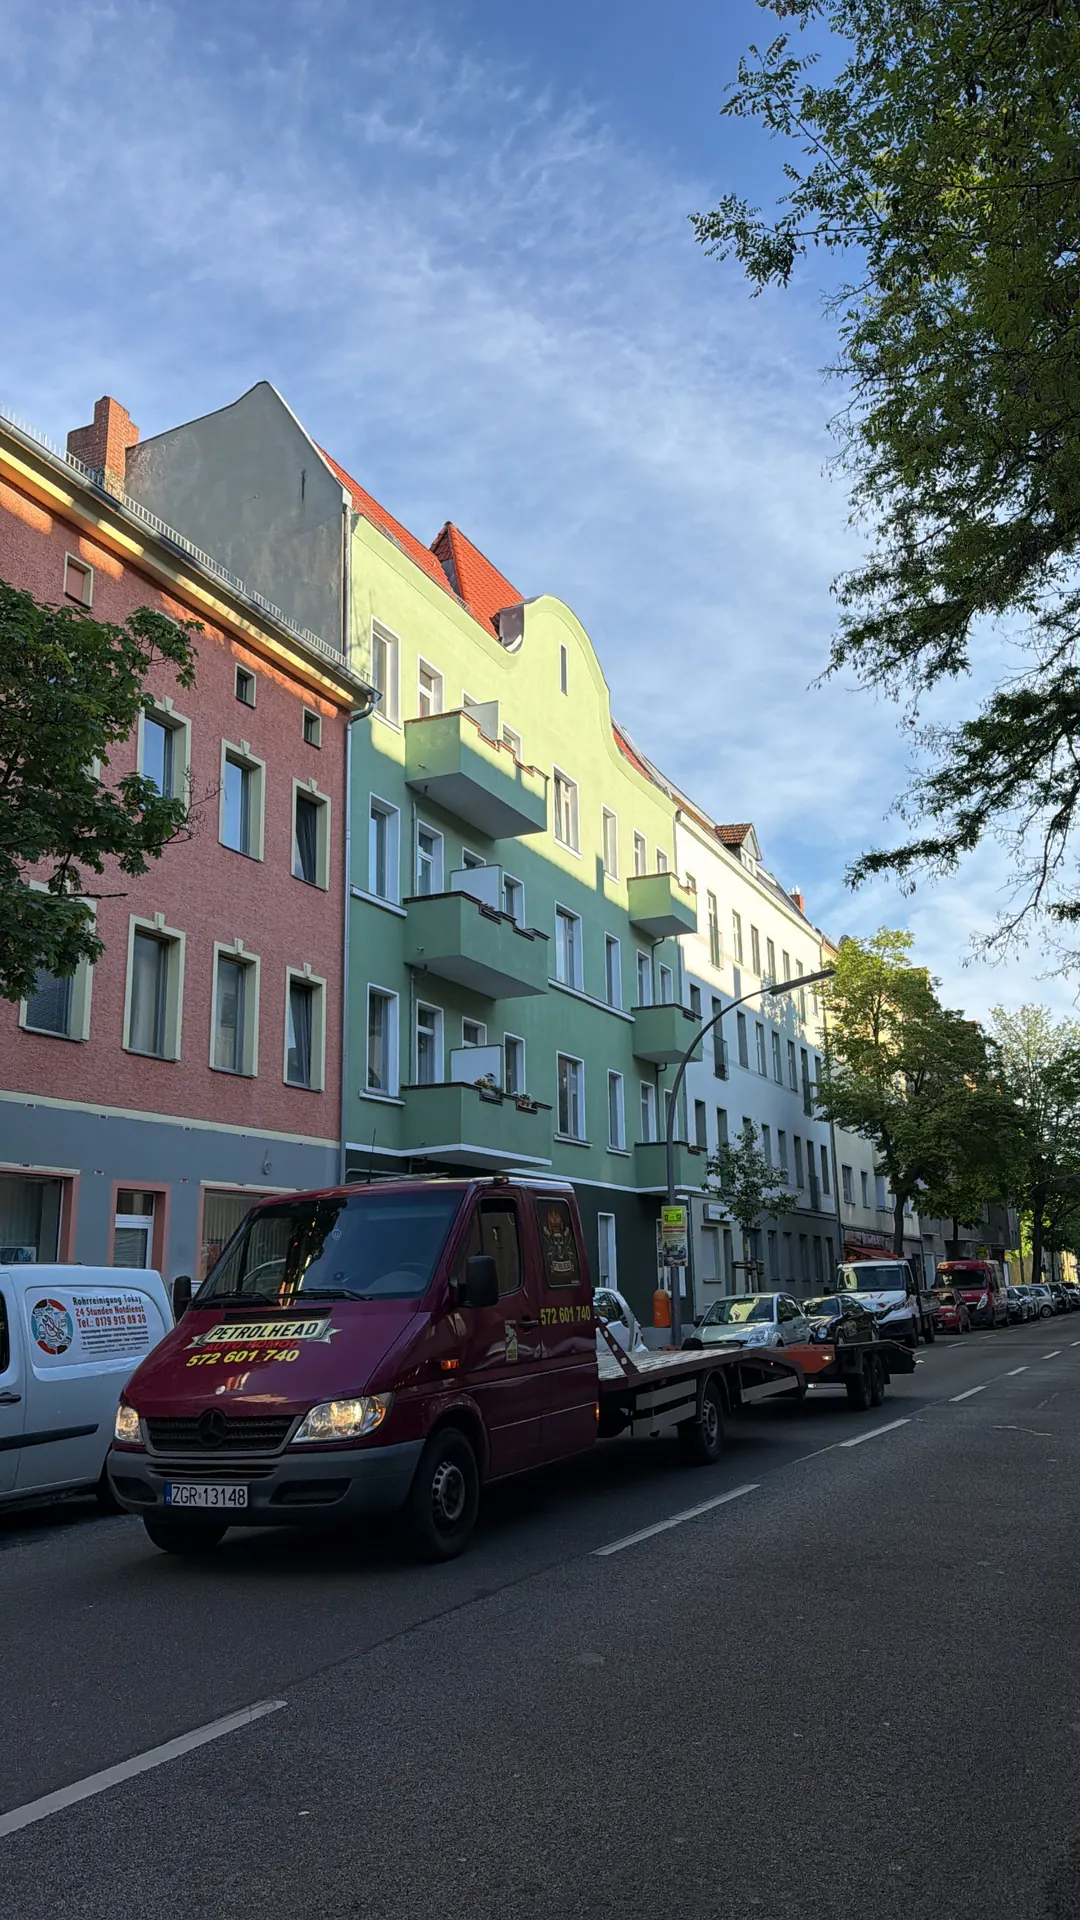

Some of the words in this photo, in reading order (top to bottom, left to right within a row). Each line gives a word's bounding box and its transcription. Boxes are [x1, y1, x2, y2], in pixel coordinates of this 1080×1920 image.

[72, 1296, 122, 1306] Rohrreinigung
[75, 1308, 84, 1317] 24
[86, 1306, 113, 1316] Stunden
[114, 1305, 145, 1315] Notdienst
[540, 1308, 558, 1325] 572
[559, 1307, 574, 1323] 601
[576, 1305, 591, 1321] 740
[77, 1318, 94, 1328] Tel.:
[95, 1316, 112, 1327] 0179
[113, 1315, 126, 1325] 915
[138, 1314, 147, 1323] 39
[208, 1322, 320, 1340] PETROLHEAD
[205, 1341, 243, 1351] AUTO
[186, 1352, 220, 1367] 572
[223, 1350, 257, 1363] 601
[263, 1349, 300, 1362] 740
[172, 1486, 198, 1505] ZGR
[203, 1487, 246, 1506] 13148
